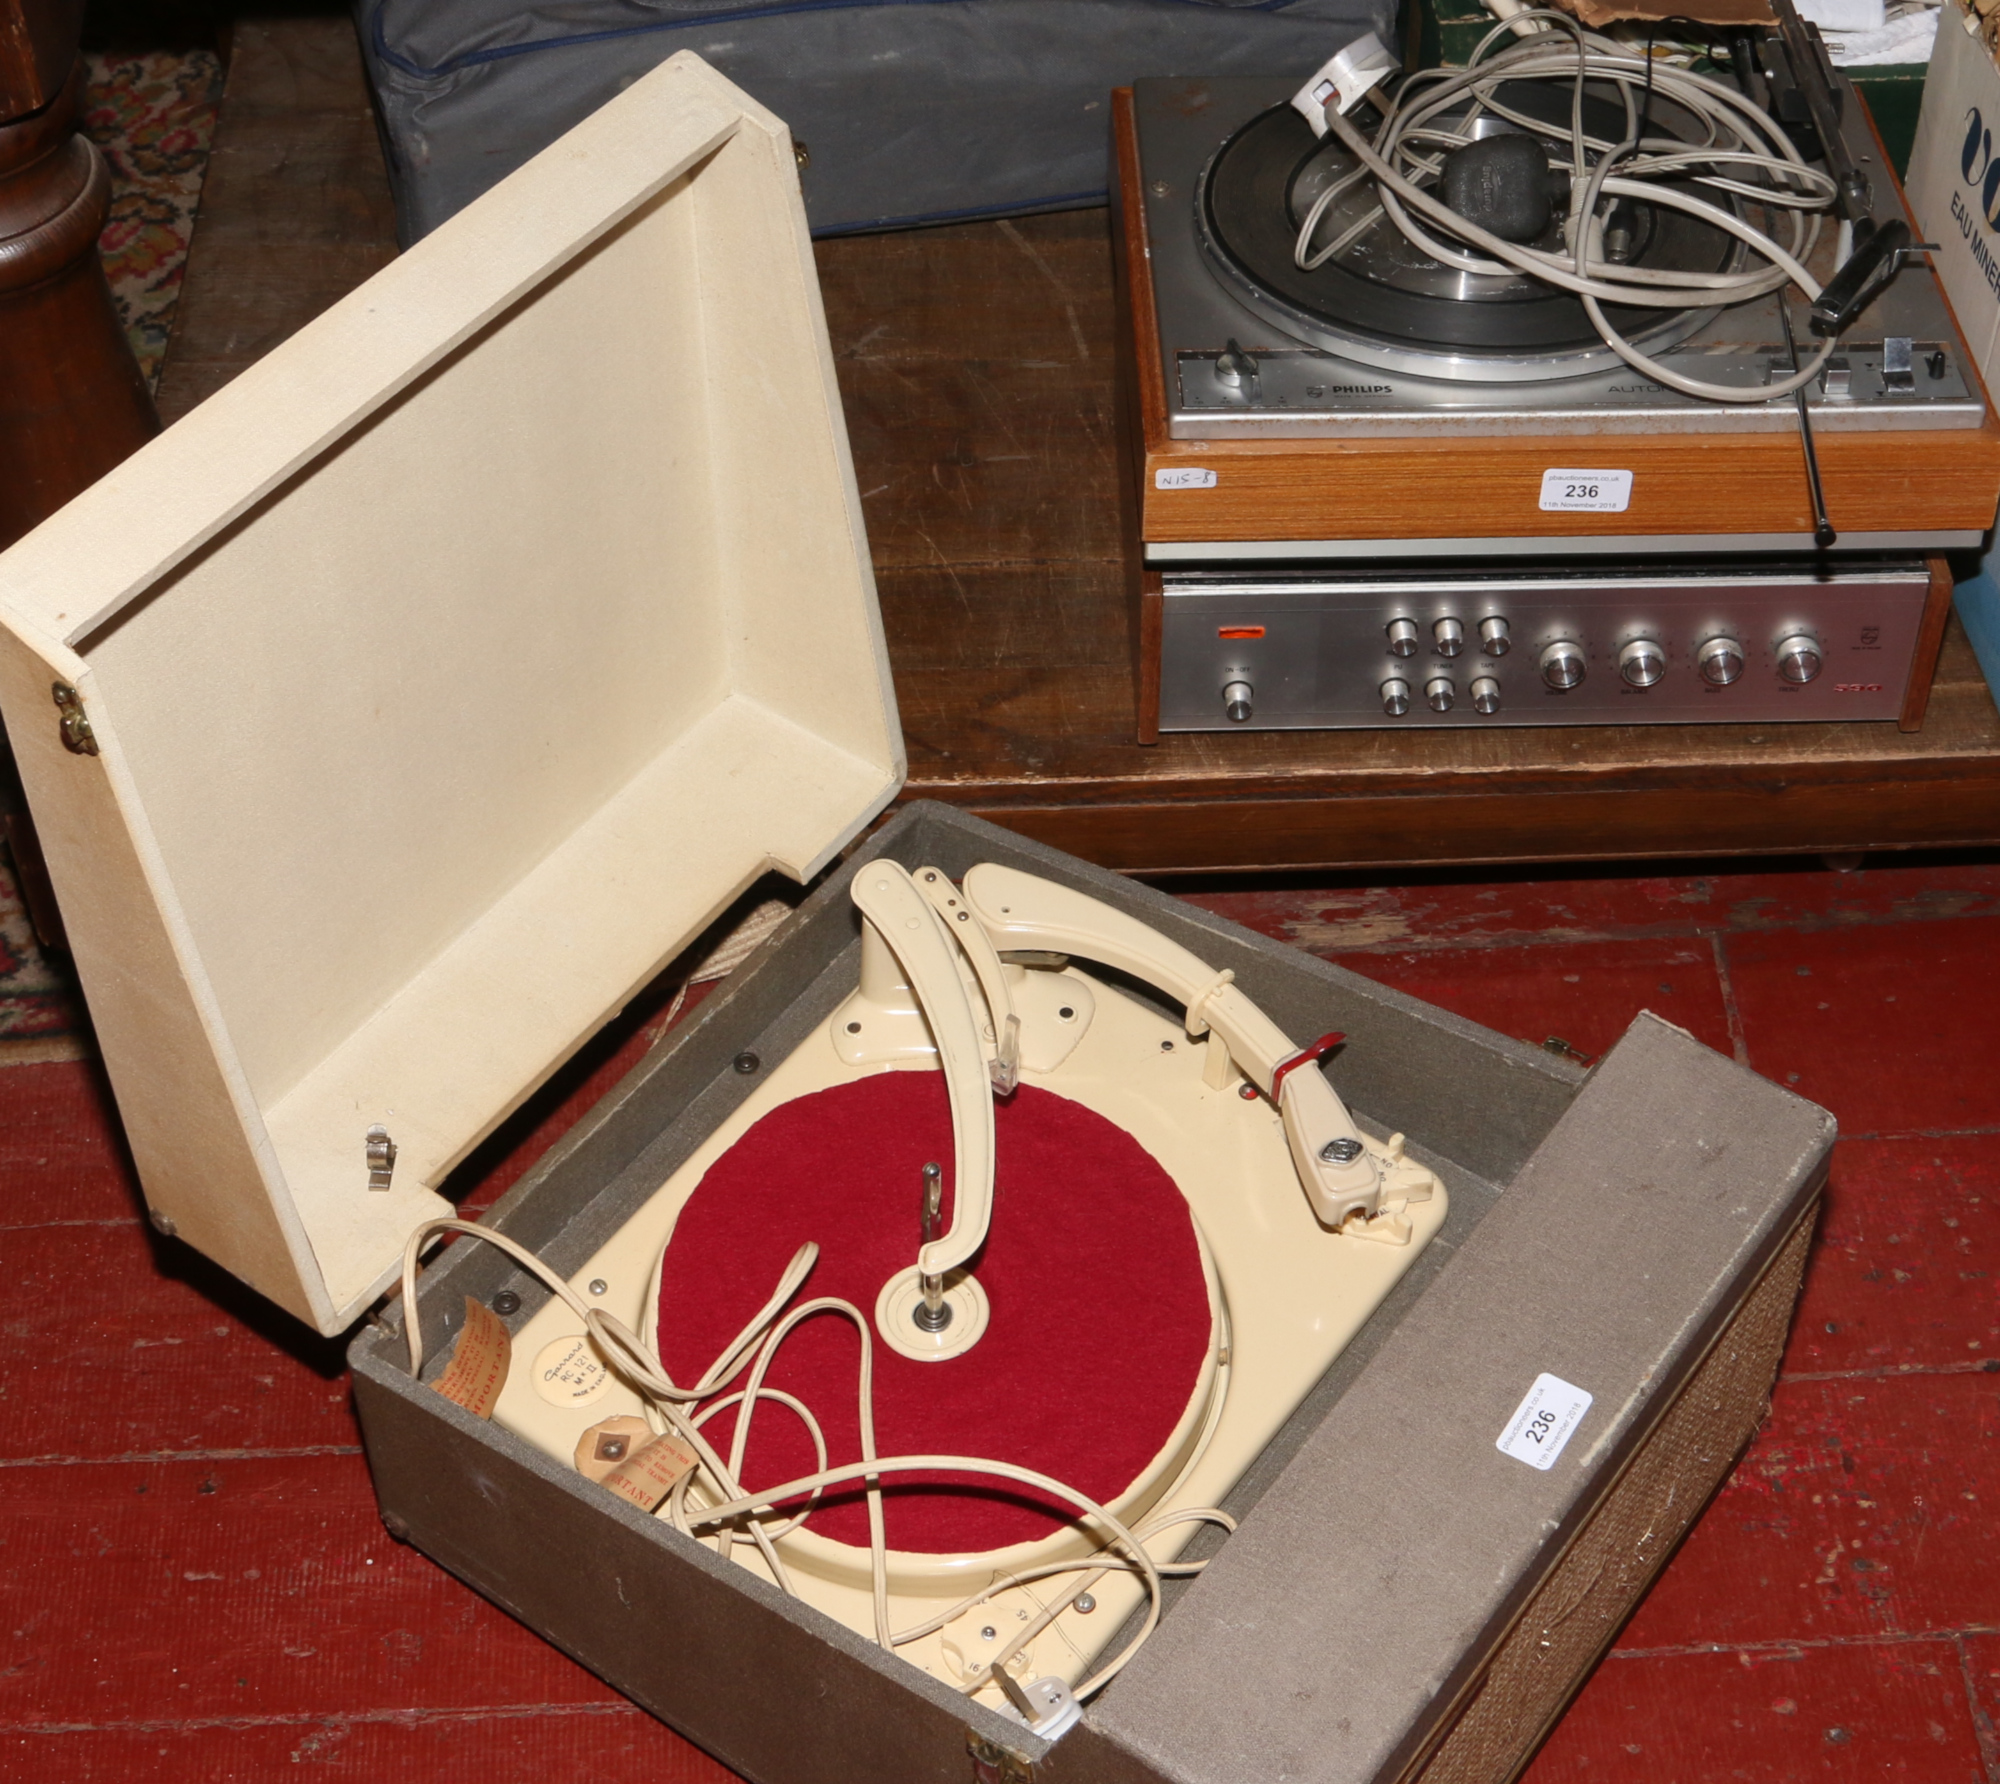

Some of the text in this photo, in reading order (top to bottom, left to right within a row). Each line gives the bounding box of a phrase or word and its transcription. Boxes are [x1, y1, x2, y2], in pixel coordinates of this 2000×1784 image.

[1950, 190, 1973, 240] EAU
[1332, 385, 1393, 394] PHILIPS
[1548, 475, 1620, 483] pbauctioneers.co.uk
[1565, 484, 1600, 498] 236
[1560, 501, 1597, 509] November
[544, 1341, 584, 1382] Garrard
[560, 1355, 589, 1383] RC 121
[572, 1389, 589, 1397] MADE
[1502, 1387, 1546, 1451] pbauctioneers.co.uk
[1525, 1410, 1556, 1444] 236
[1536, 1402, 1582, 1467] 11th November 2018
[1016, 1609, 1028, 1622] 45
[1012, 1650, 1026, 1665] 33
[968, 1662, 981, 1673] 16
